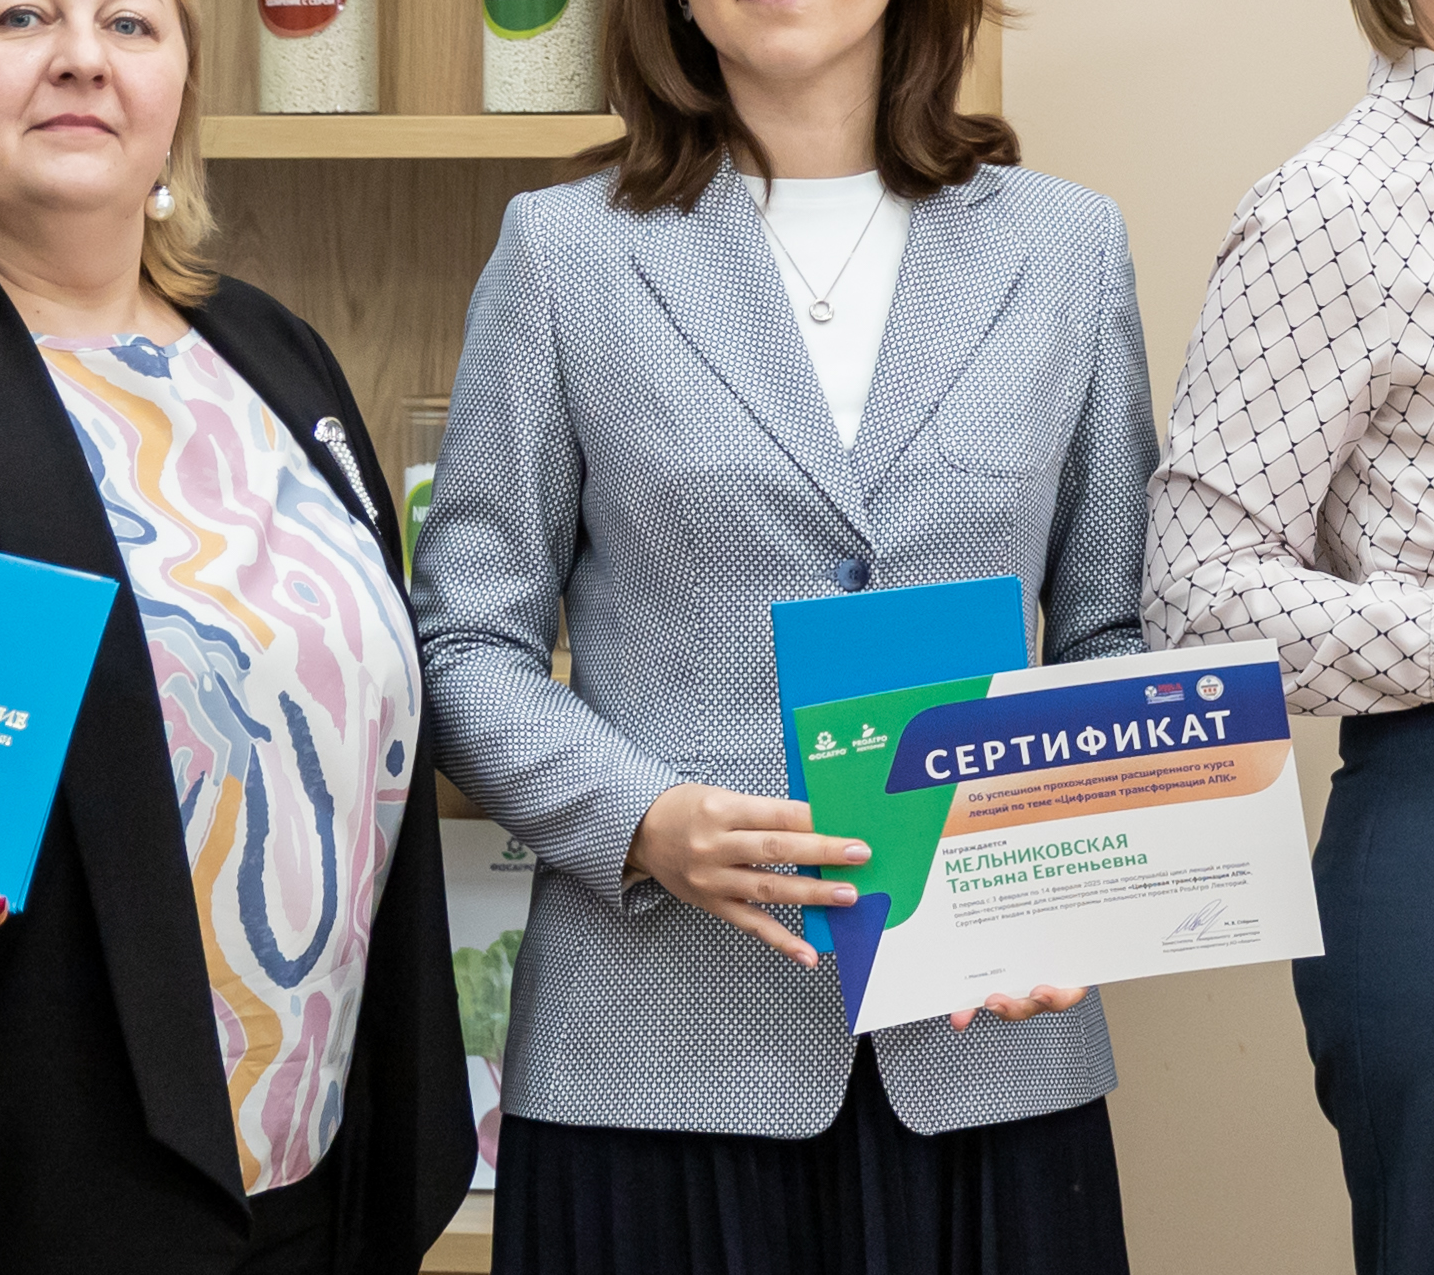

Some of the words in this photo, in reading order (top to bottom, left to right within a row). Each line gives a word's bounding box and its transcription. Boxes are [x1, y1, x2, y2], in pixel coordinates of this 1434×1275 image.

[924, 709, 1231, 780] СЕРТИФИКАТ
[967, 791, 985, 804] Об
[984, 784, 1043, 803] успешном
[1042, 774, 1119, 794] прохождении
[1120, 763, 1202, 783] расширенного
[1202, 759, 1236, 773] курса
[967, 804, 1010, 819] лекций
[1010, 802, 1026, 812] по
[1026, 798, 1053, 809] теме
[1053, 789, 1118, 805] «Цифровая
[1117, 777, 1207, 798] трансформация
[1207, 773, 1238, 785] АПК»
[941, 839, 1008, 856] Награждается
[944, 832, 1129, 877] МЕЛЬНИКОВСКАЯ
[945, 870, 1029, 894] Татьяна
[1032, 852, 1149, 881] Евгеньевна
